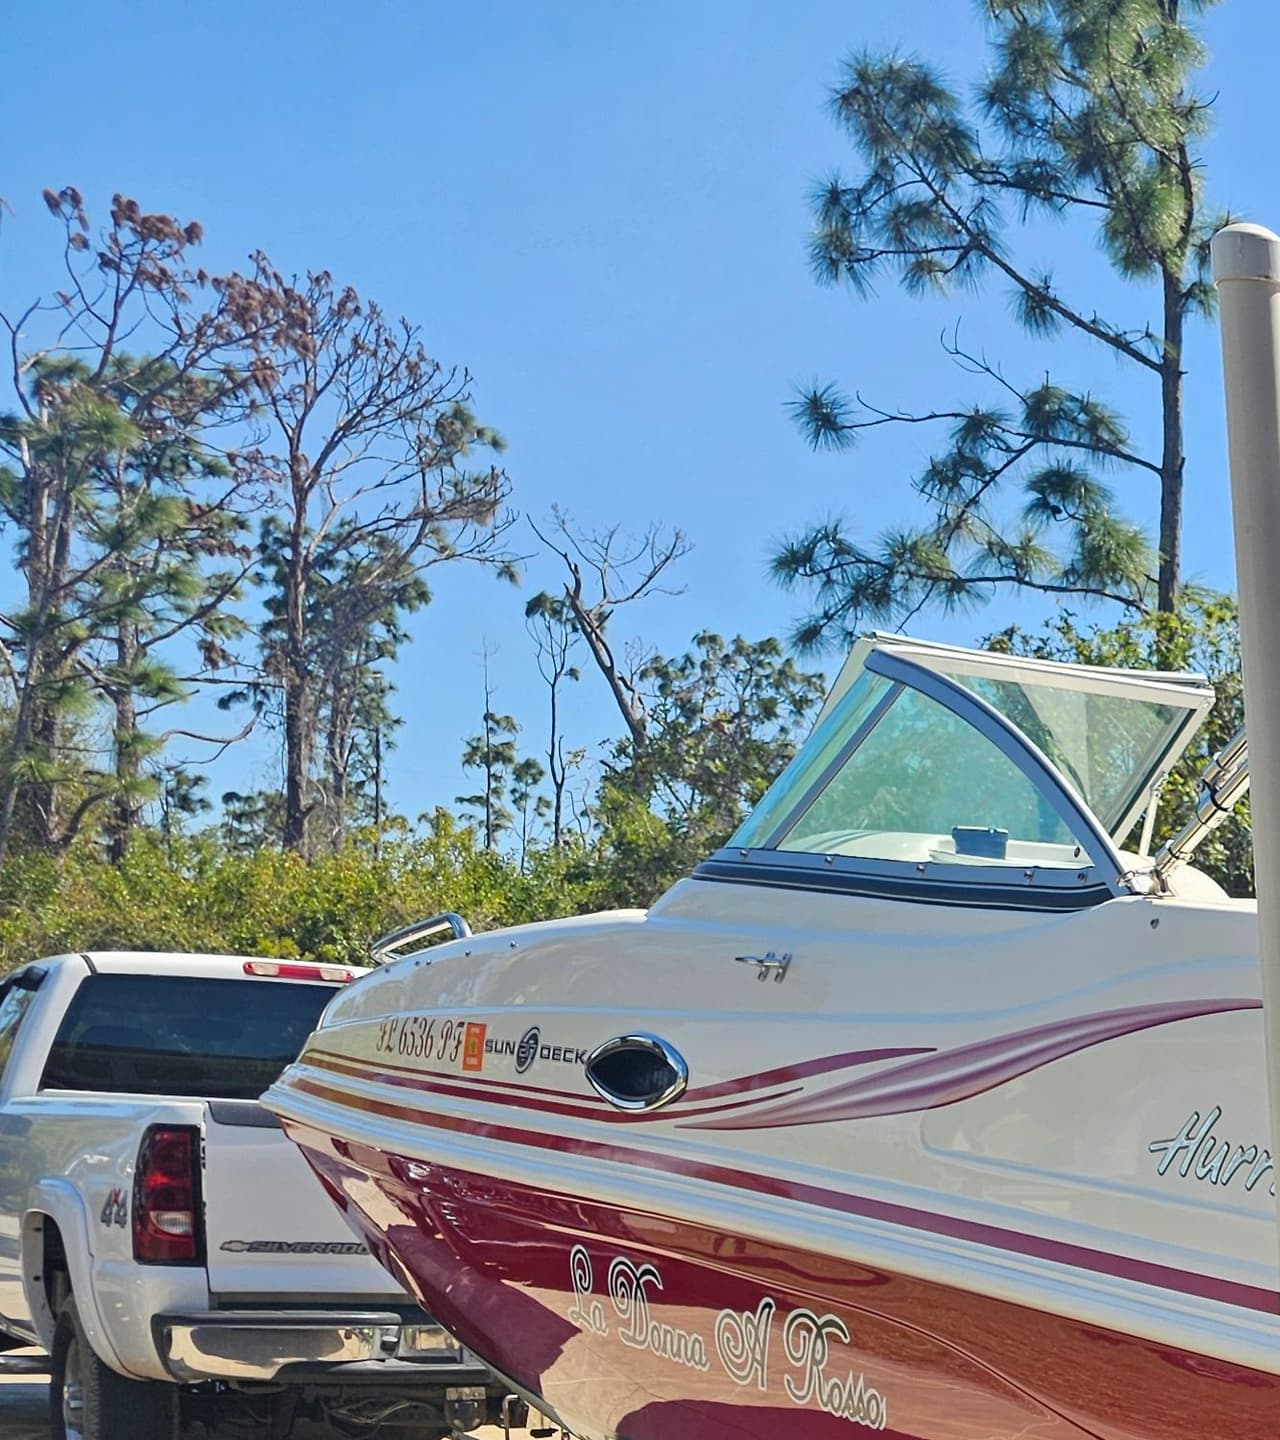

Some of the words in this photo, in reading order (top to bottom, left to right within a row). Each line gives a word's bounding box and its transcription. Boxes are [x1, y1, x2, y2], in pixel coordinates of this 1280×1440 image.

[399, 1017, 436, 1058] 6536
[484, 1038, 516, 1056] SUN
[540, 1044, 587, 1065] DECK
[568, 1244, 609, 1336] La
[607, 1256, 709, 1373] Donna
[714, 1297, 776, 1391] A
